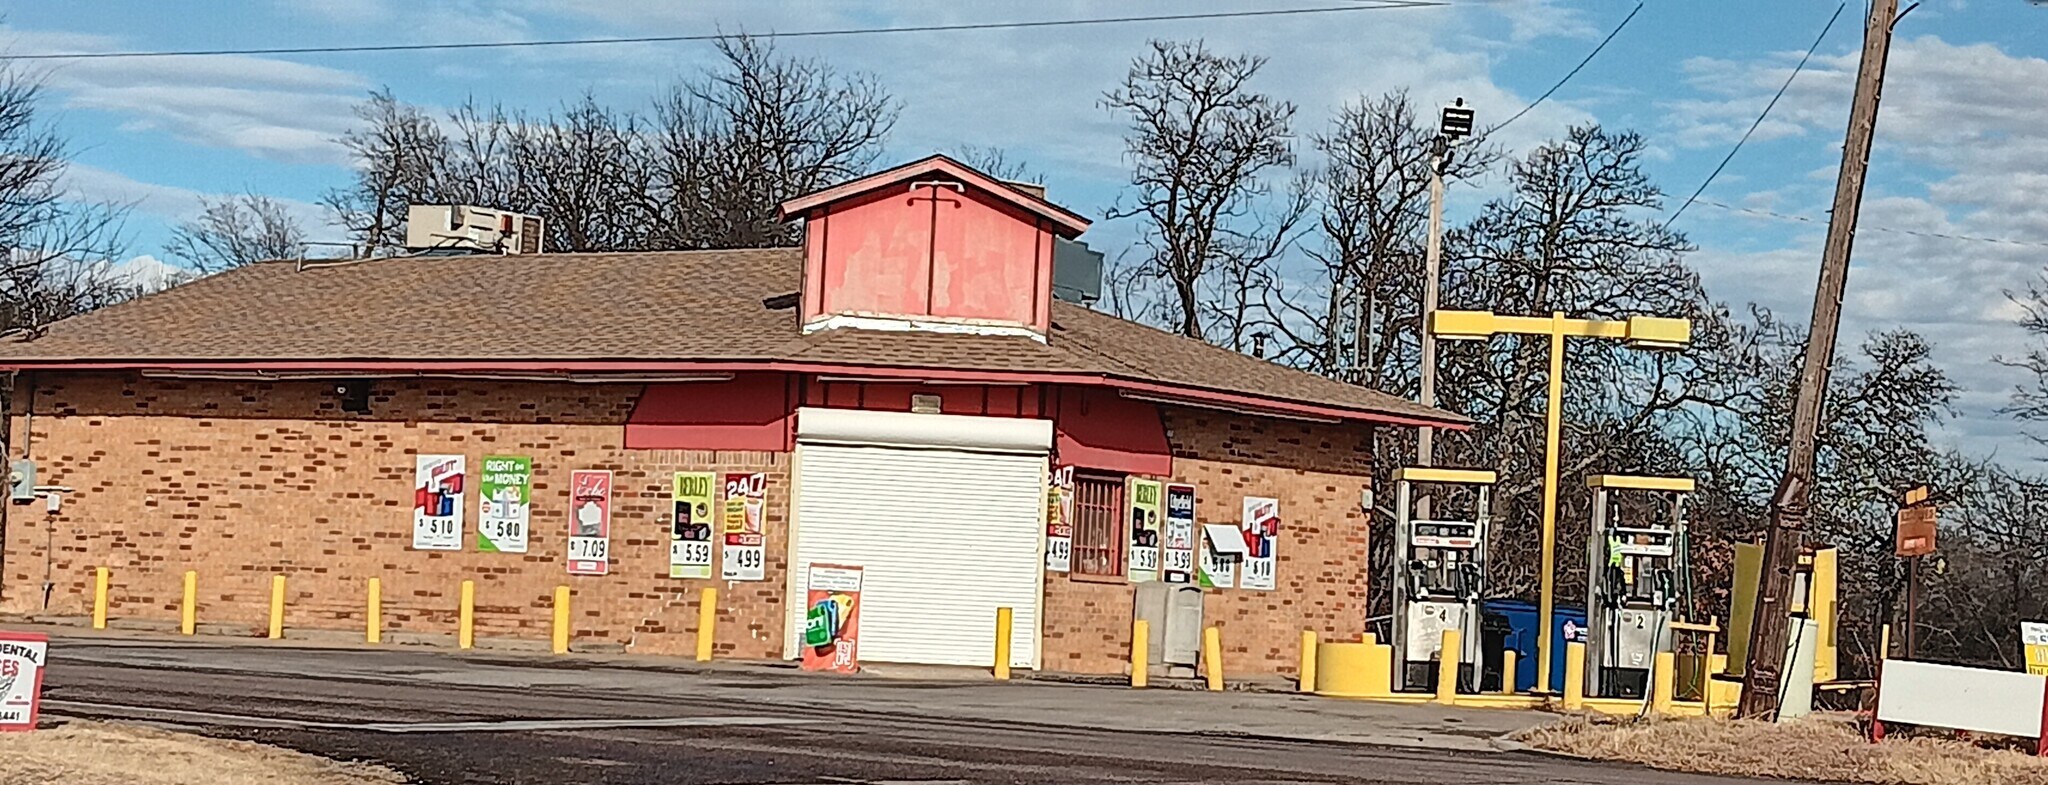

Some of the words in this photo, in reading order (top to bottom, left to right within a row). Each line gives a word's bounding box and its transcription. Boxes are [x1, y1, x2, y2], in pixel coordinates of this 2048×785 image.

[486, 460, 515, 472] RIGHT
[495, 473, 530, 485] MONEY
[582, 540, 605, 557] 7.09
[685, 544, 709, 562] 5.59
[1439, 609, 1447, 622] 4
[1636, 615, 1644, 629] 2
